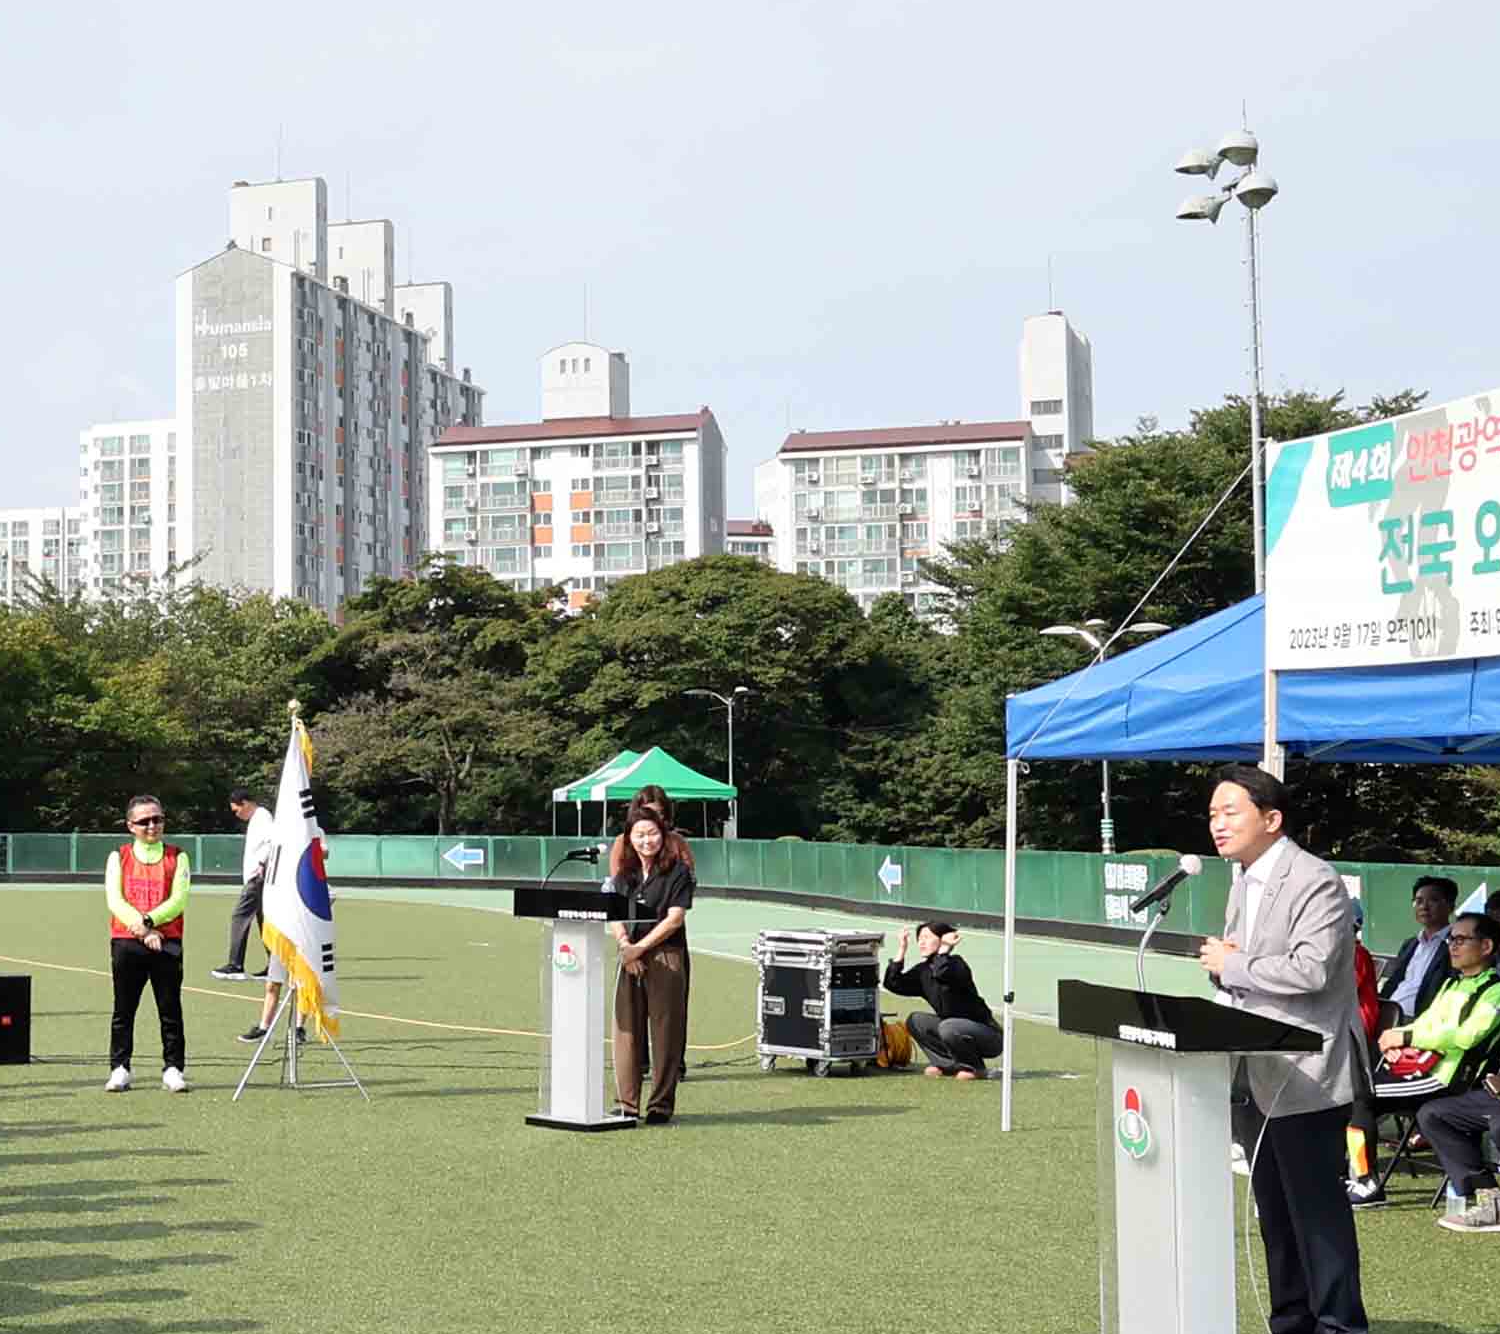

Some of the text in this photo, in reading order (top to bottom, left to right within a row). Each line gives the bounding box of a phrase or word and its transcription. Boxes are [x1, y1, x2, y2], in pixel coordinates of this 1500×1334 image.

[1330, 440, 1391, 490] 제4회
[1378, 508, 1457, 595] 전국
[1289, 614, 1437, 650] 2023년 9월 17일 오전10시
[1469, 610, 1491, 635] 주최
